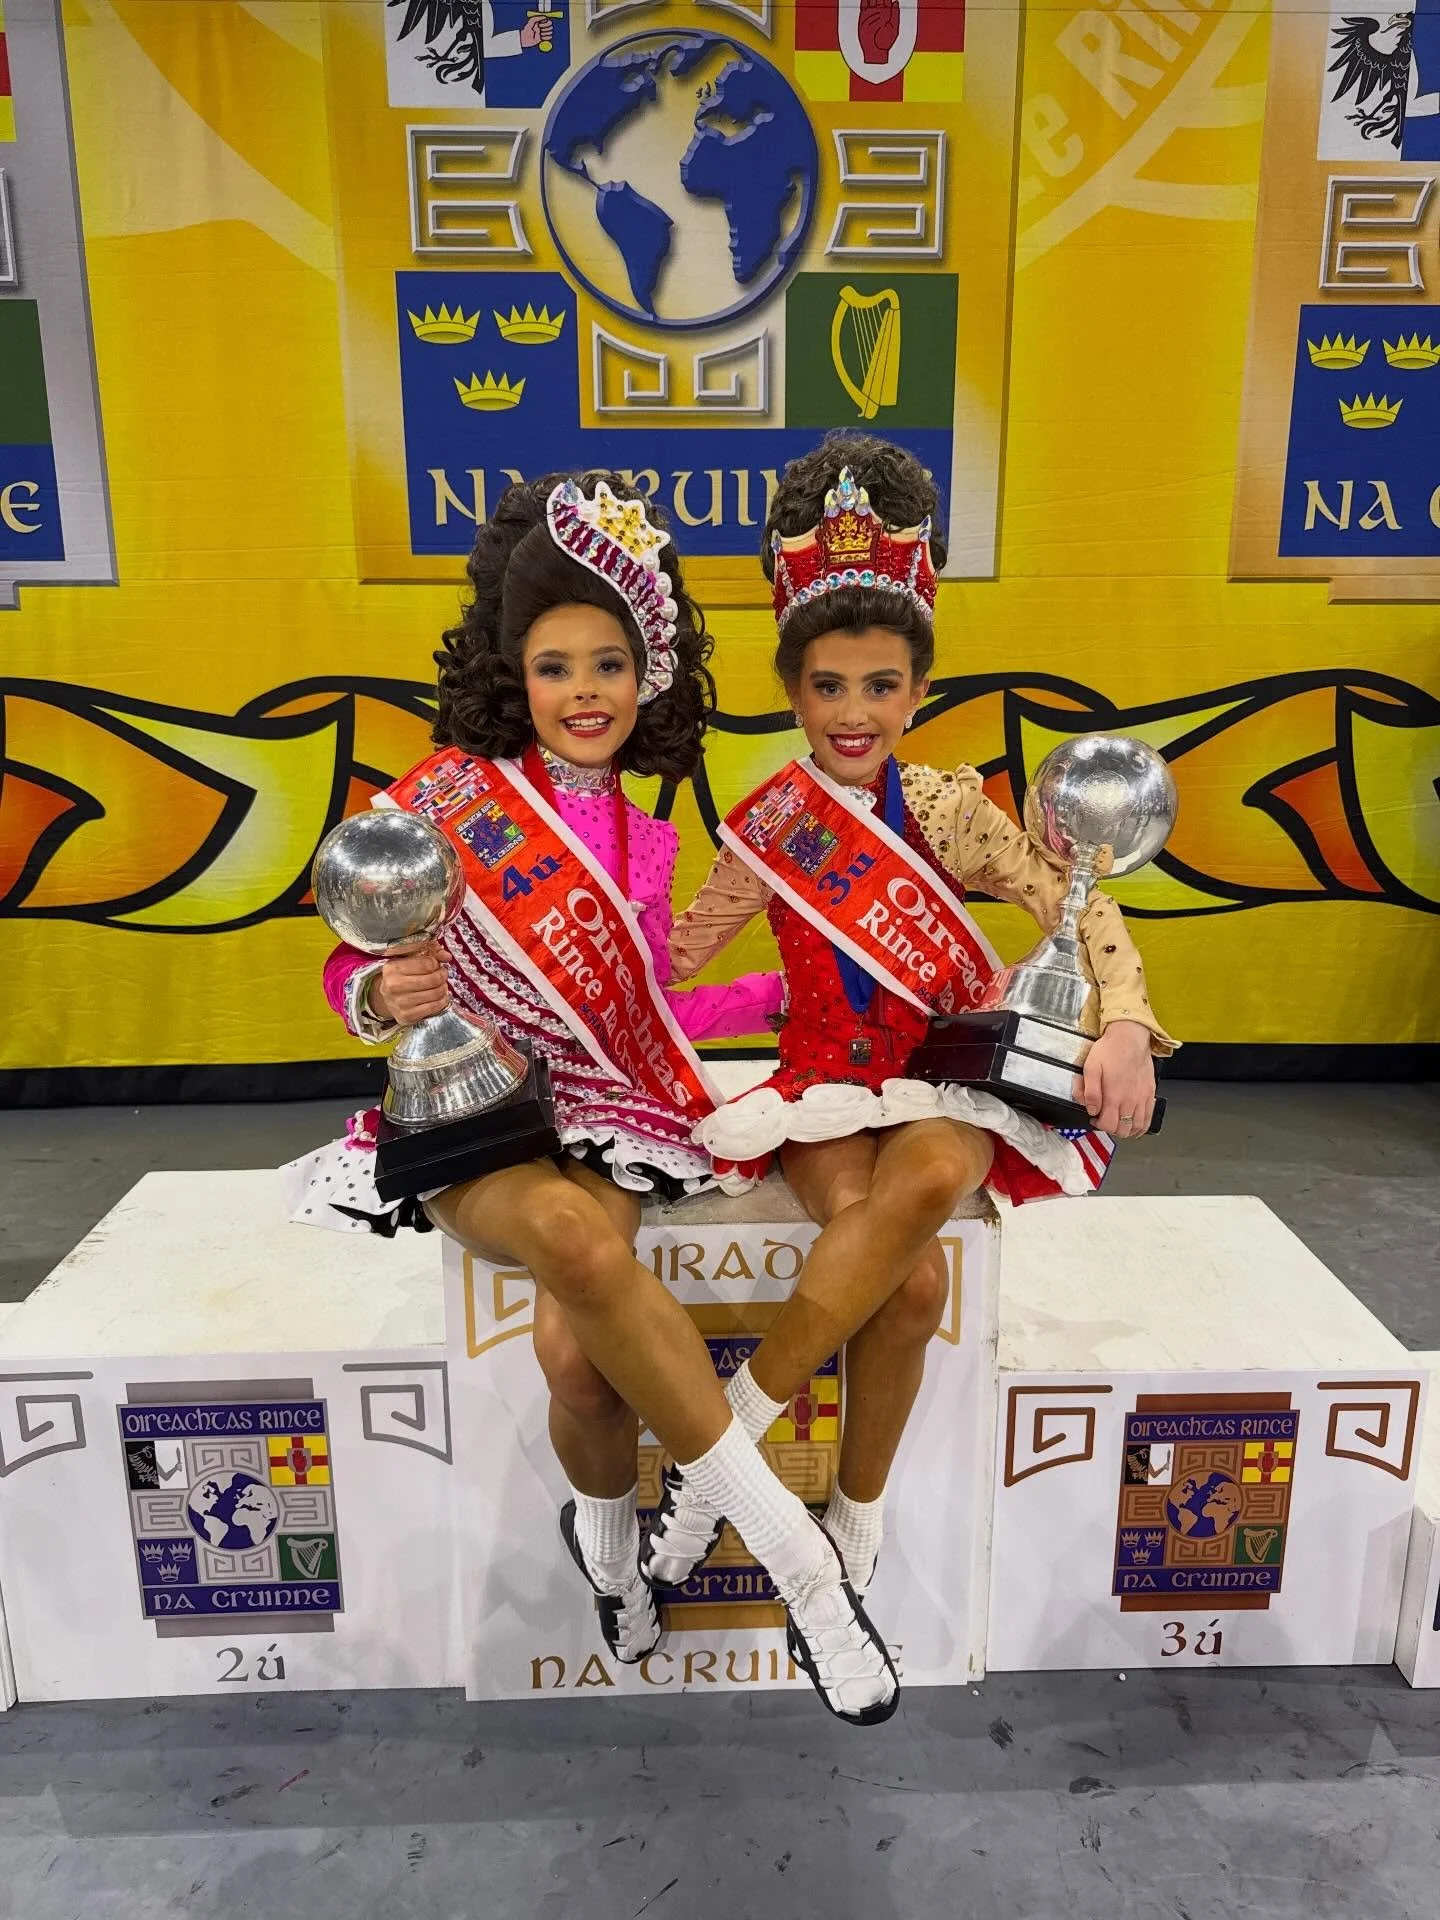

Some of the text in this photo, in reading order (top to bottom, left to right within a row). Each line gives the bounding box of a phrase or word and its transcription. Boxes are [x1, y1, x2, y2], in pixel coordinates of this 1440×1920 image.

[1304, 480, 1403, 531] NA
[503, 853, 563, 902] 4ú
[530, 906, 603, 1001] Rince
[856, 899, 937, 983] Rince
[887, 877, 987, 1004] Oireac
[566, 887, 694, 1107] Oireachtas
[215, 1642, 287, 1683] 2ú
[1160, 1618, 1224, 1657] 3ú
[530, 1653, 616, 1690] NA
